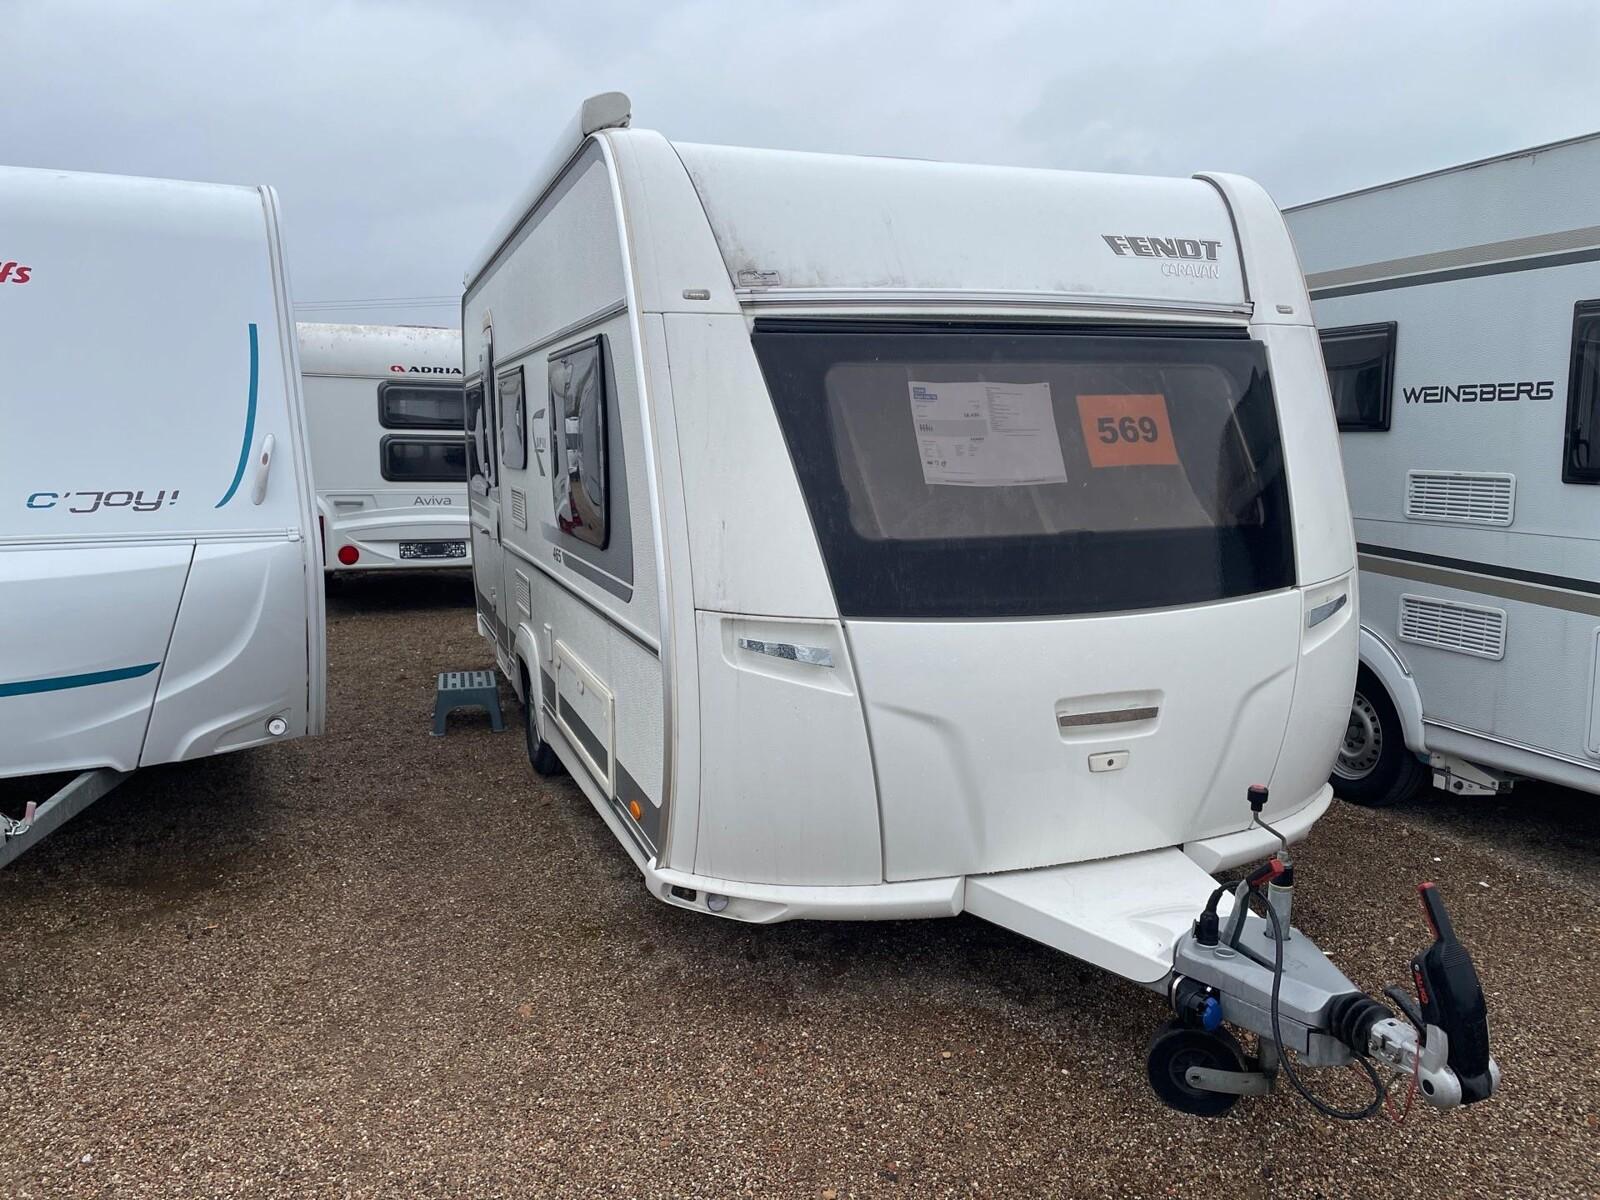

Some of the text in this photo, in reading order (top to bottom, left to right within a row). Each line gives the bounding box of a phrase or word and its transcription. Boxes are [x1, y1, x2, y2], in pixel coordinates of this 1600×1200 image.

[1101, 234, 1222, 261] FENDT
[1161, 262, 1219, 279] CARAVAN
[408, 366, 462, 375] ADRIA
[1403, 381, 1554, 404] WEINSBERG
[1097, 416, 1158, 443] 569
[414, 496, 452, 506] Aviva
